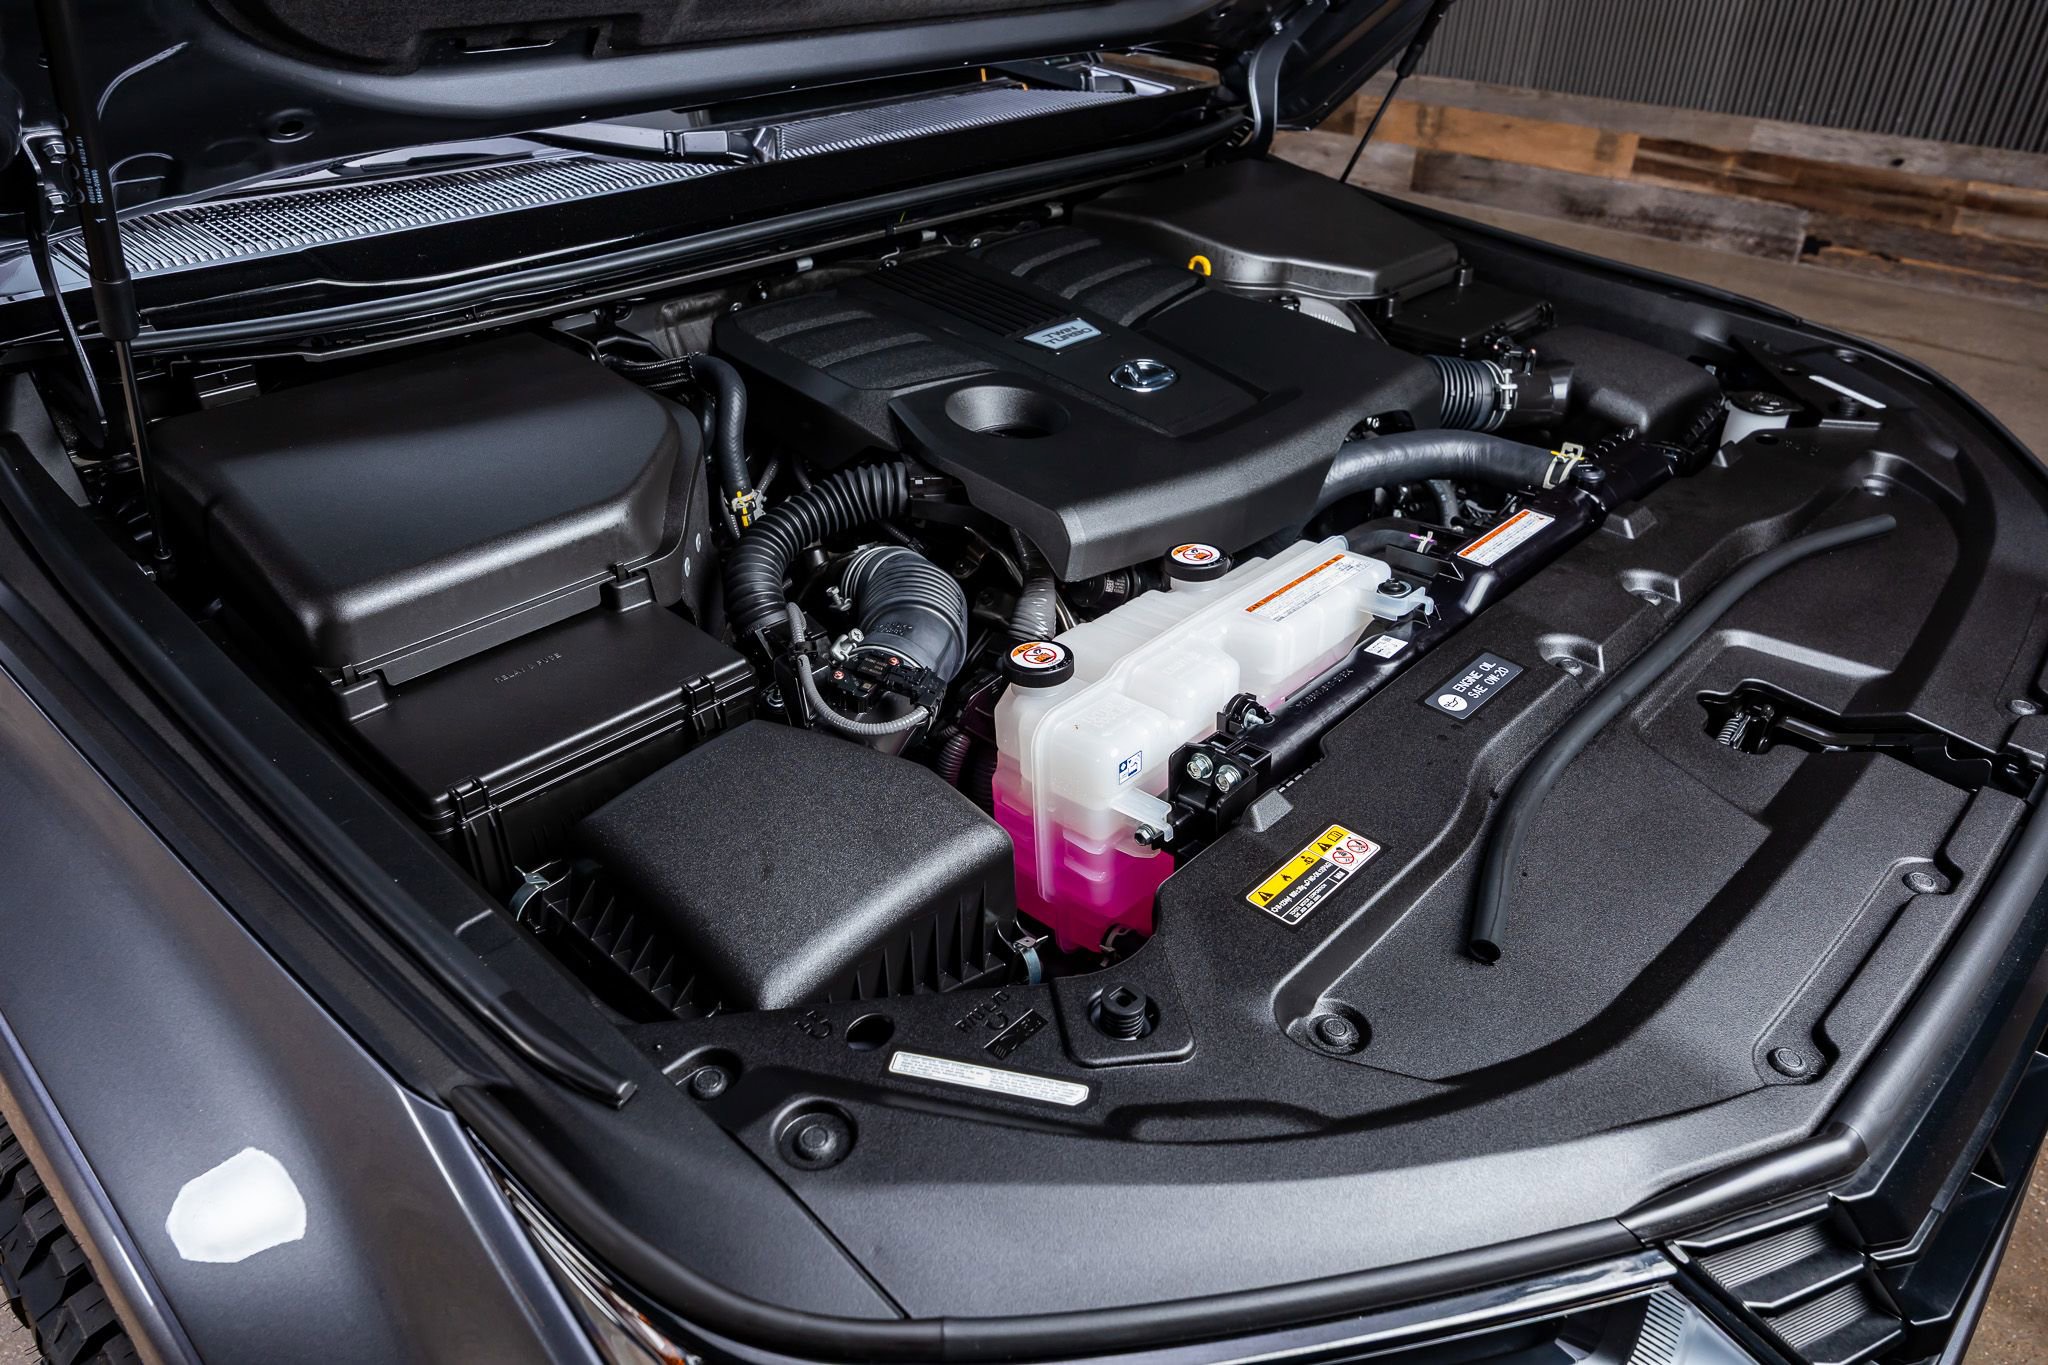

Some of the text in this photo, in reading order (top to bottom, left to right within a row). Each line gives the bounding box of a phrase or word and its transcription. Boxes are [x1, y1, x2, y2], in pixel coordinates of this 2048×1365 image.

[1042, 326, 1077, 338] TWIN
[1044, 328, 1093, 344] TURBO
[1452, 661, 1496, 693] ENGINE OIL
[1467, 666, 1509, 699] SAE 0W-20
